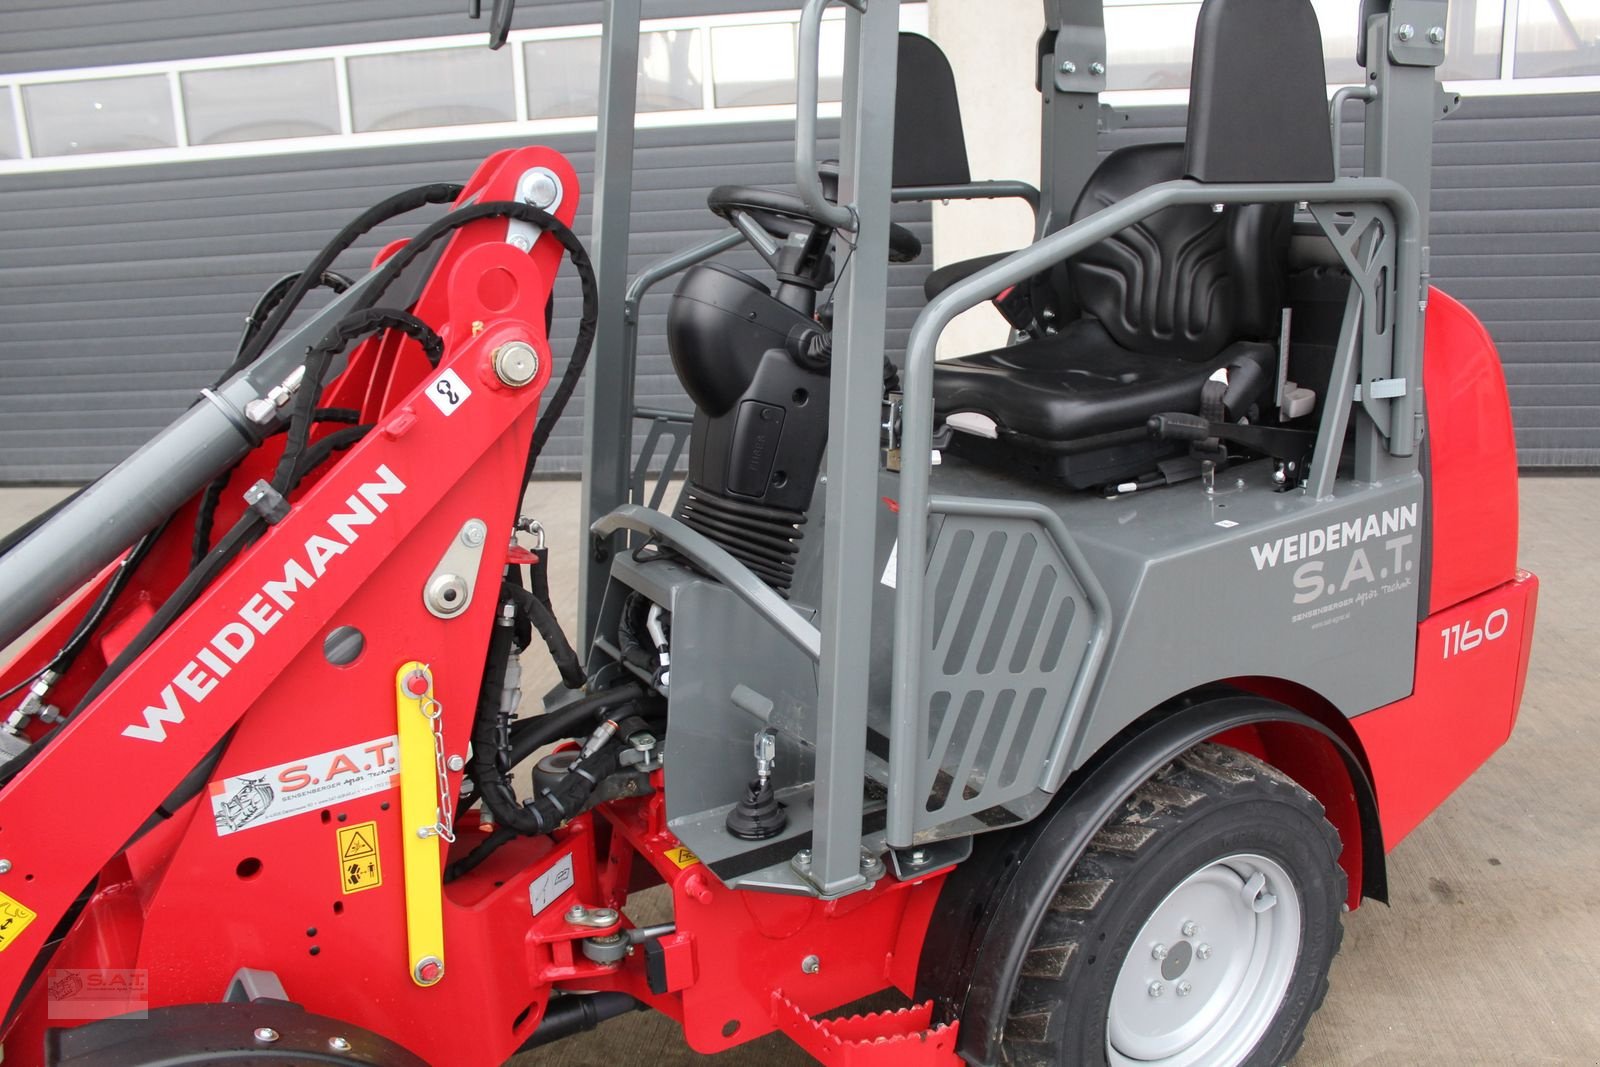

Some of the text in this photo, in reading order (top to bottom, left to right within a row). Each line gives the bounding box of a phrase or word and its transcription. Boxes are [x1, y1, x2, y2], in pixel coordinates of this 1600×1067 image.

[1250, 503, 1418, 571] WEIDEMANN
[1293, 534, 1413, 604] S.A.T.
[121, 464, 407, 742] WEIDEMANN
[1441, 608, 1509, 659] 1160
[278, 742, 396, 793] S.A.T.
